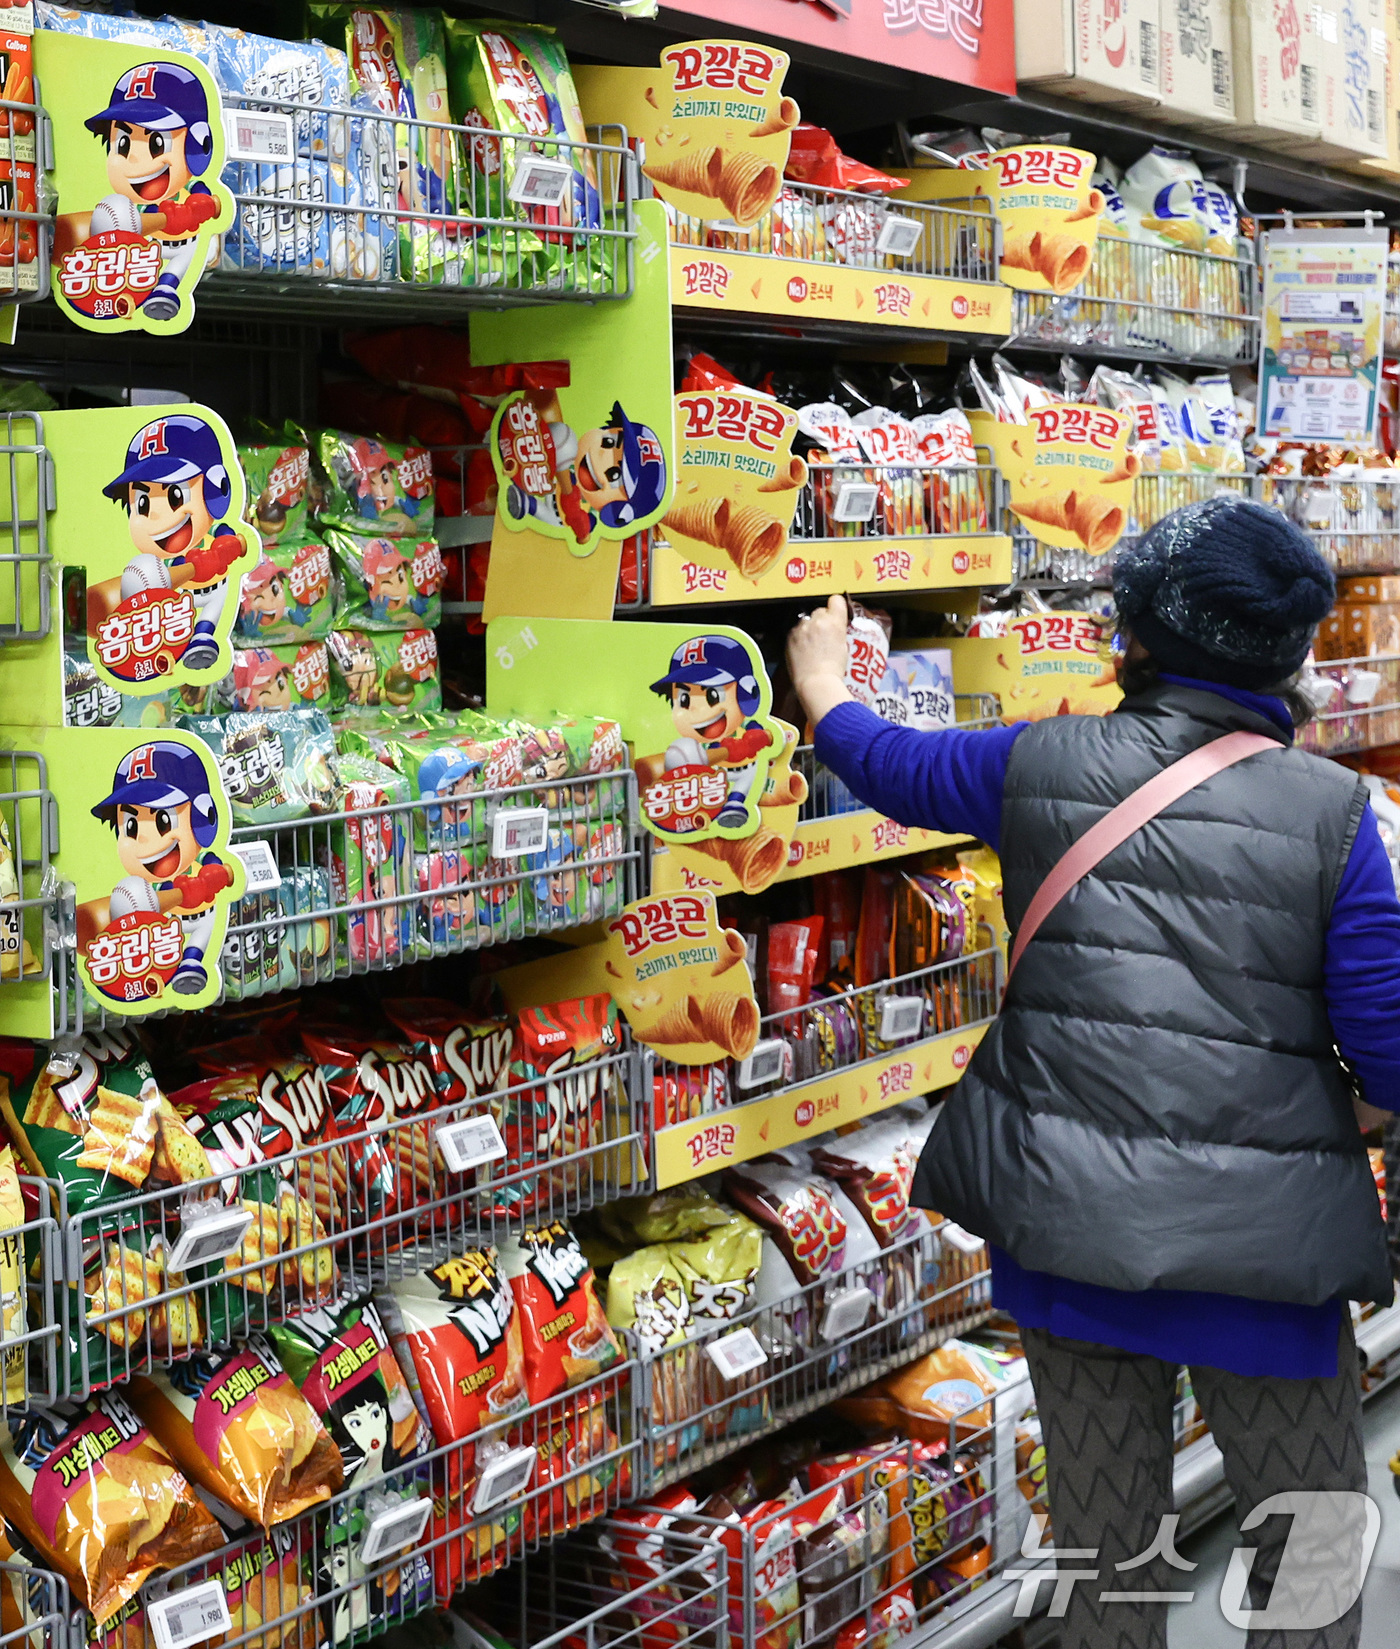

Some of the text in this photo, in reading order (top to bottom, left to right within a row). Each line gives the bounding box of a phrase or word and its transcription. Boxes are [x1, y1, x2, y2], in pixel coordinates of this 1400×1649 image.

[6, 39, 28, 52] Calbee
[125, 65, 157, 100] H
[665, 46, 773, 96] 꼬깔콘
[672, 98, 766, 123] 소리까지 맛있다!
[9, 166, 31, 179] Clbee
[992, 150, 1081, 189] 꼬깔콘
[60, 244, 161, 296] 홈런볼
[682, 261, 730, 299] 꼬깔콘
[874, 284, 913, 317] 꼬깔콘
[94, 299, 114, 318] 초코
[138, 420, 169, 461] H
[679, 397, 786, 452] 꼬깔콘
[1030, 408, 1119, 450] 꼬깔콘
[509, 402, 552, 494] 홈런볼
[682, 447, 775, 478] 소리까지 맛있다!
[268, 449, 310, 499] 홈런볼
[398, 452, 433, 489] 홈런볼
[289, 552, 331, 597] 홈런볼
[411, 549, 447, 588] 홈런볼
[681, 560, 728, 592] 꼬깔콘
[786, 564, 806, 577] No.1
[873, 551, 911, 583] 꼬깔콘
[98, 596, 194, 664] 홈런볼
[1012, 618, 1103, 654] 꼬깔콘
[134, 660, 155, 680] 초코
[399, 635, 438, 673] 홈런볼
[681, 638, 707, 666] H
[846, 639, 887, 695] 깔콘
[292, 652, 330, 699] 홈런볼
[911, 690, 950, 723] 꼬깔콘
[127, 745, 157, 783] H
[220, 731, 285, 798] 홈런볼
[644, 772, 727, 818] 홈런볼
[608, 896, 708, 958] 꼬깔콘
[88, 919, 182, 982] 홈런볼
[635, 945, 719, 983] 소리까지 맛있다!
[124, 982, 144, 1001] 초코
[360, 1050, 438, 1138] Sun
[444, 1026, 514, 1119] Sun
[256, 1065, 331, 1179] Sun
[686, 1123, 736, 1168] 꼬깔콘
[877, 1063, 913, 1100] 꼬깔콘
[211, 1366, 257, 1415] 가성비
[324, 1348, 362, 1391] 가성비
[52, 1430, 105, 1487] 가성비
